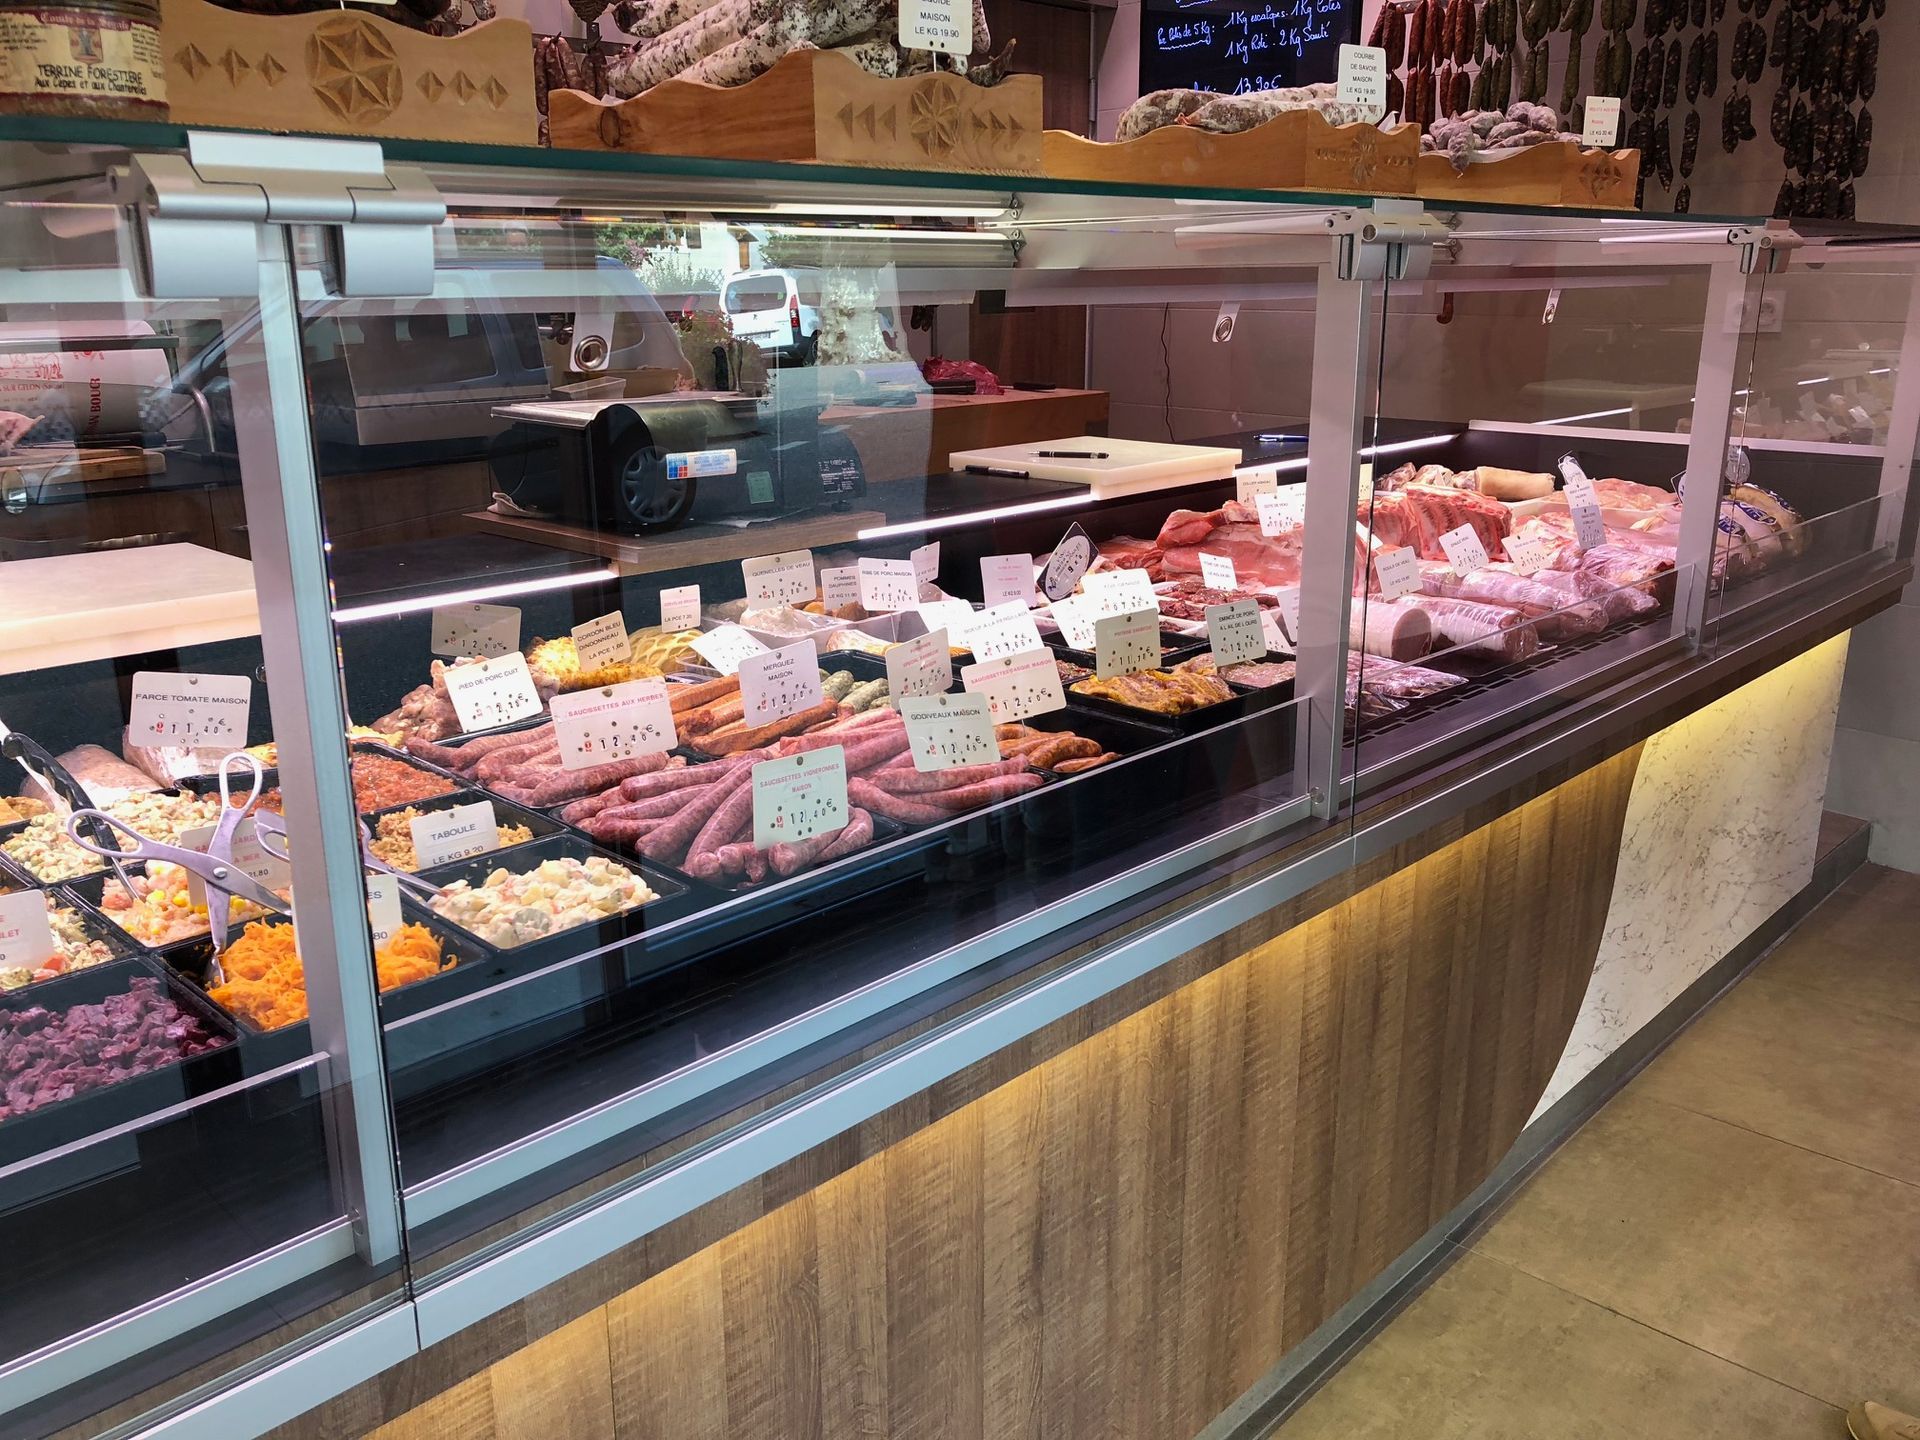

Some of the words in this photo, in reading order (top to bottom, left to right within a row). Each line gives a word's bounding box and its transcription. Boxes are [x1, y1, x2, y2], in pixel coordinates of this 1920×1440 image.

[919, 12, 951, 22] MAISON
[915, 26, 925, 35] LE
[927, 27, 939, 36] KG
[940, 28, 960, 38] 19.90
[1353, 52, 1375, 60] COURBE
[37, 64, 83, 79] TERRINE
[1350, 63, 1358, 71] DE
[1359, 64, 1377, 72] SAVOIE
[752, 567, 785, 577] QUENELLES
[577, 627, 605, 642] CORDON
[605, 621, 621, 632] BLEU
[597, 648, 611, 657] PCE
[763, 658, 795, 672] MERGUEZ
[458, 681, 474, 690] PIED
[485, 672, 503, 682] PORC
[504, 667, 519, 677] CUIT
[768, 670, 793, 681] MAISON
[135, 693, 168, 702] FARCE
[171, 695, 209, 703] TOMATE
[211, 697, 248, 705] MAISON
[568, 702, 619, 717] SAUCISSETTES
[621, 699, 636, 707] AUX
[637, 693, 664, 703] HERBES
[910, 711, 952, 721] GODIVEAUX
[759, 772, 802, 788] SAUCISSETTES
[431, 823, 476, 841] TABOULE
[433, 855, 445, 865] LE
[448, 852, 462, 861] KG
